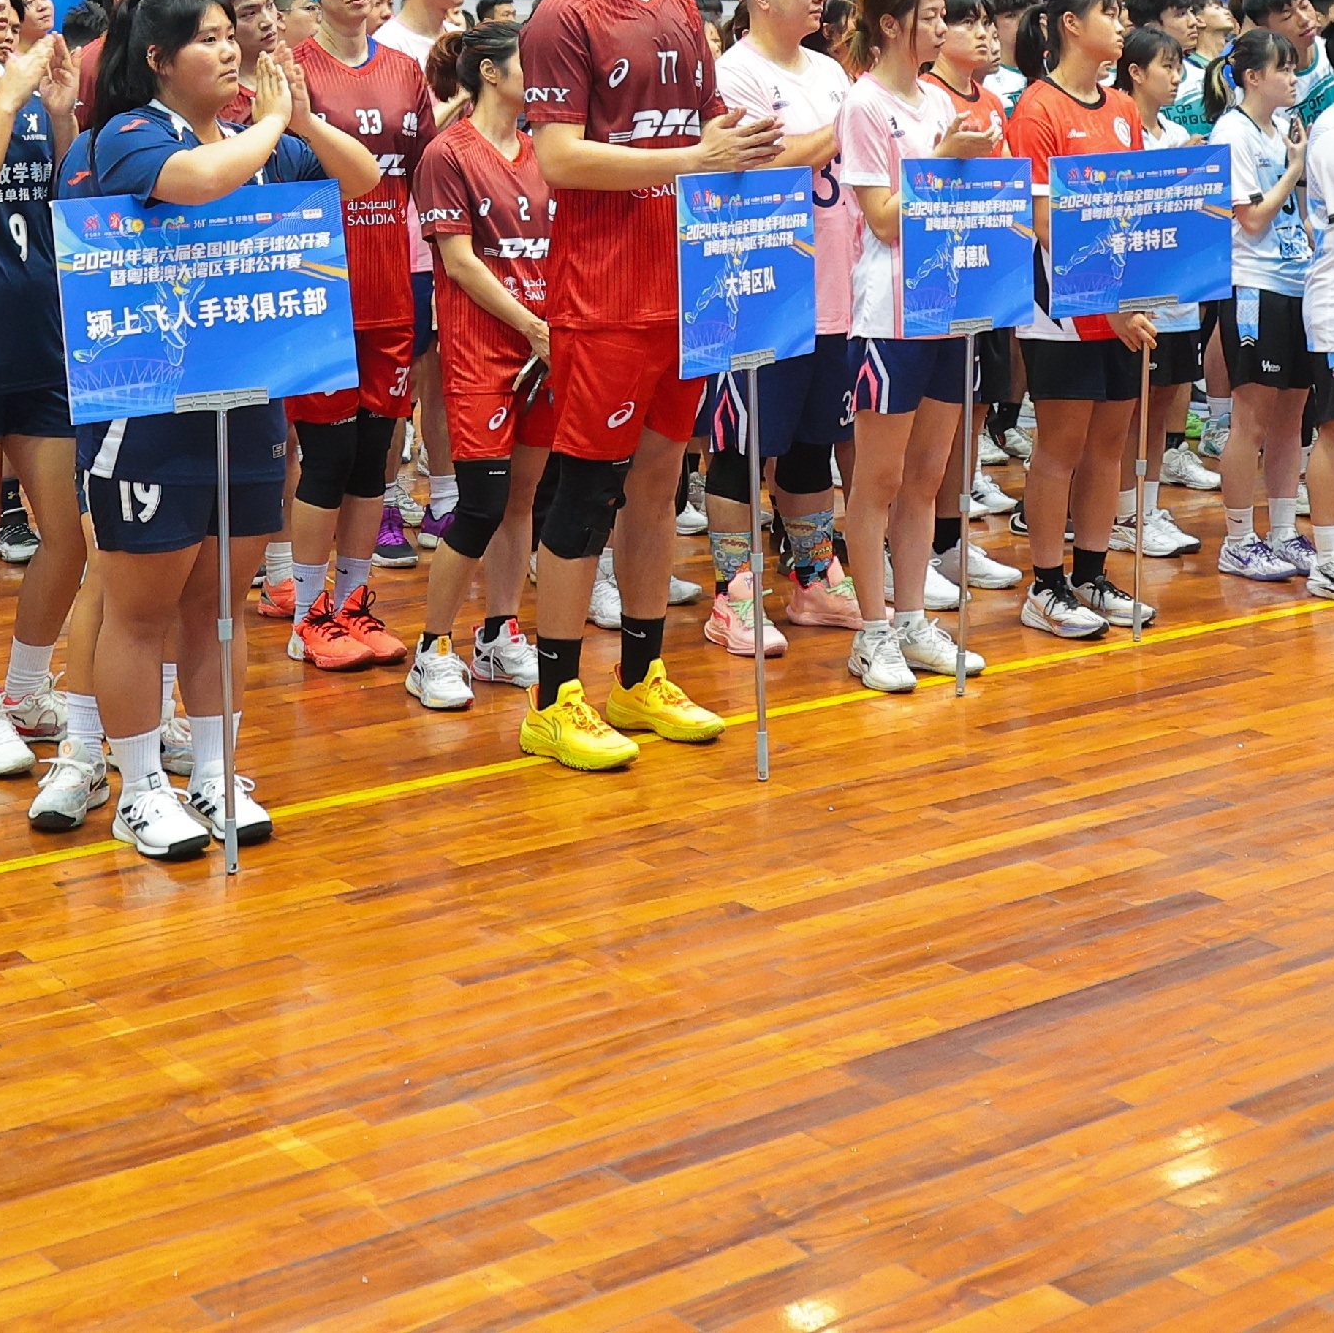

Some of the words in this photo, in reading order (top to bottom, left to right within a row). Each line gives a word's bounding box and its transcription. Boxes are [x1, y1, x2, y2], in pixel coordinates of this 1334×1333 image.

[656, 50, 680, 84] 77
[524, 87, 571, 103] ONY
[355, 109, 383, 135] 33
[347, 199, 396, 214] السعودية
[517, 196, 531, 221] 2
[1059, 182, 1224, 208] 2024年第六届全国业余手球公开赛
[347, 213, 396, 226] SAUDIA
[9, 213, 28, 262] 9
[73, 231, 331, 271] 2024年第六届全国业余手球公开赛
[1110, 227, 1178, 254] 香港特区
[110, 253, 302, 287] 暨粤港澳大湾区手球公开赛
[726, 266, 776, 297] 大湾区队
[118, 479, 162, 524] 19
